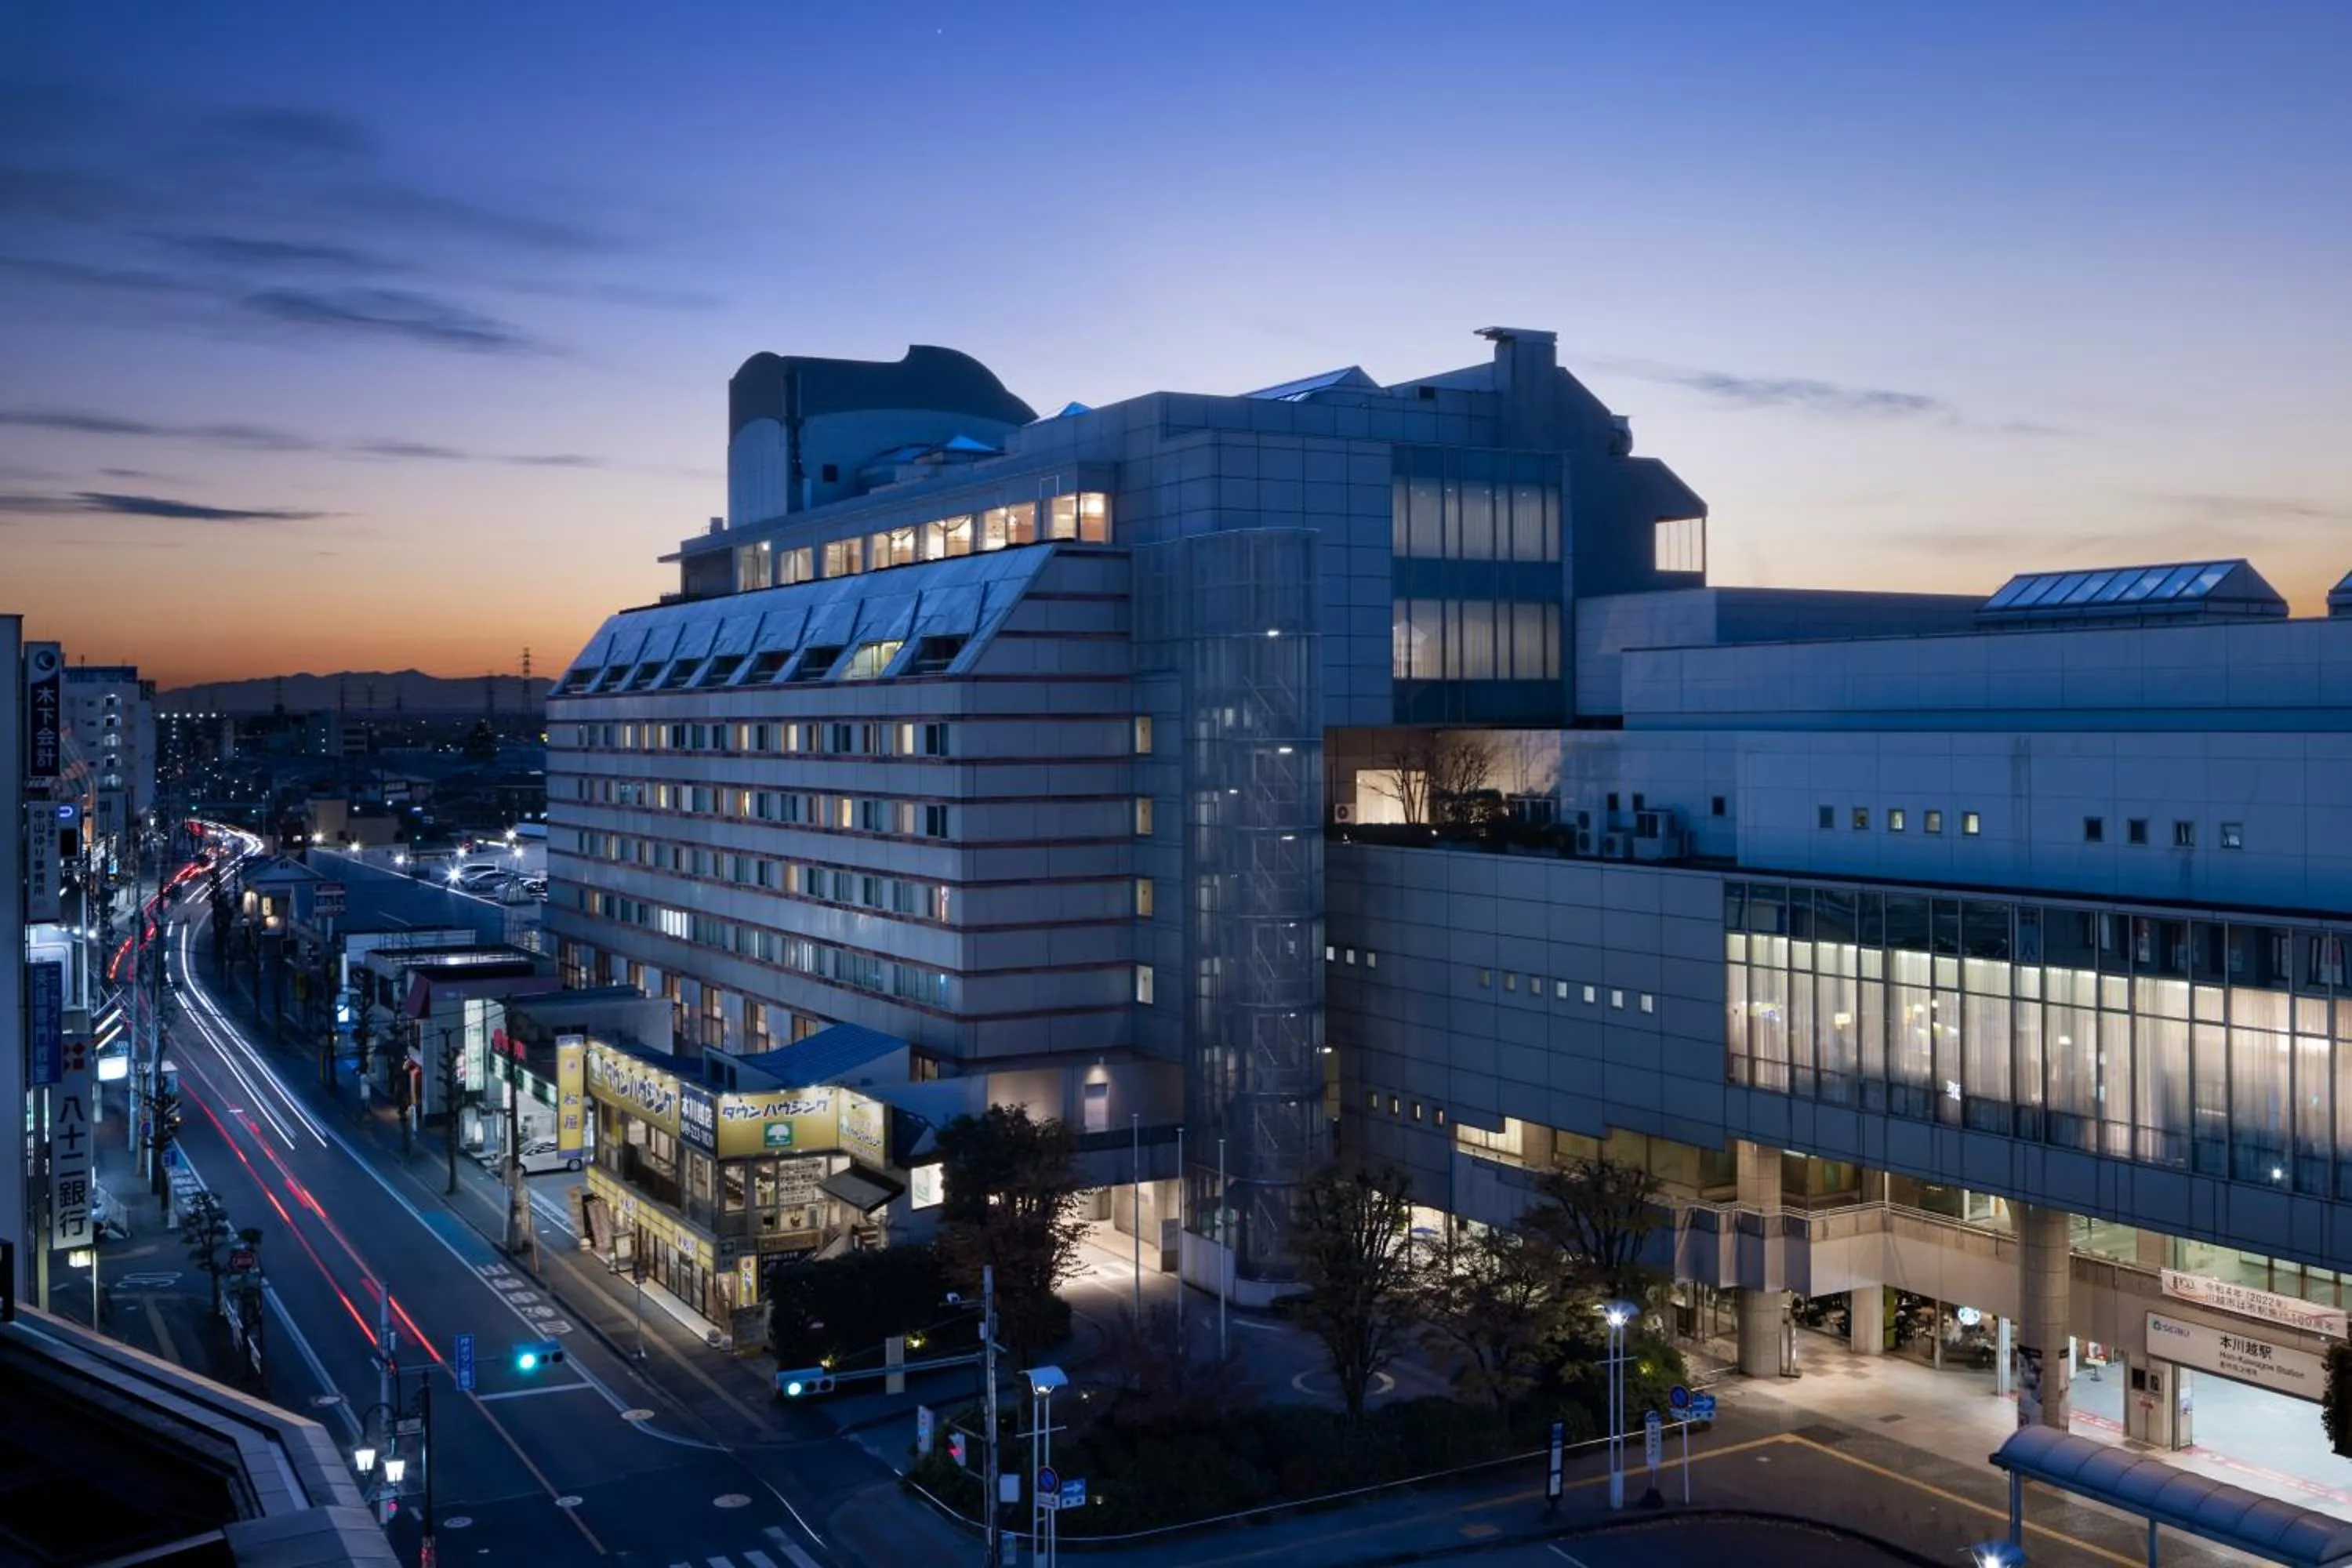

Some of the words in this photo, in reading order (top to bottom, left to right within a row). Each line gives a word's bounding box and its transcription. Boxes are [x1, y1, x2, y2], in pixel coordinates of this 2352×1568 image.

[36, 686, 56, 768] 木下会計
[722, 1099, 829, 1120] タウンハウジング
[58, 1096, 86, 1238] 八十二銀行
[2220, 1336, 2271, 1360] 本川越駅
